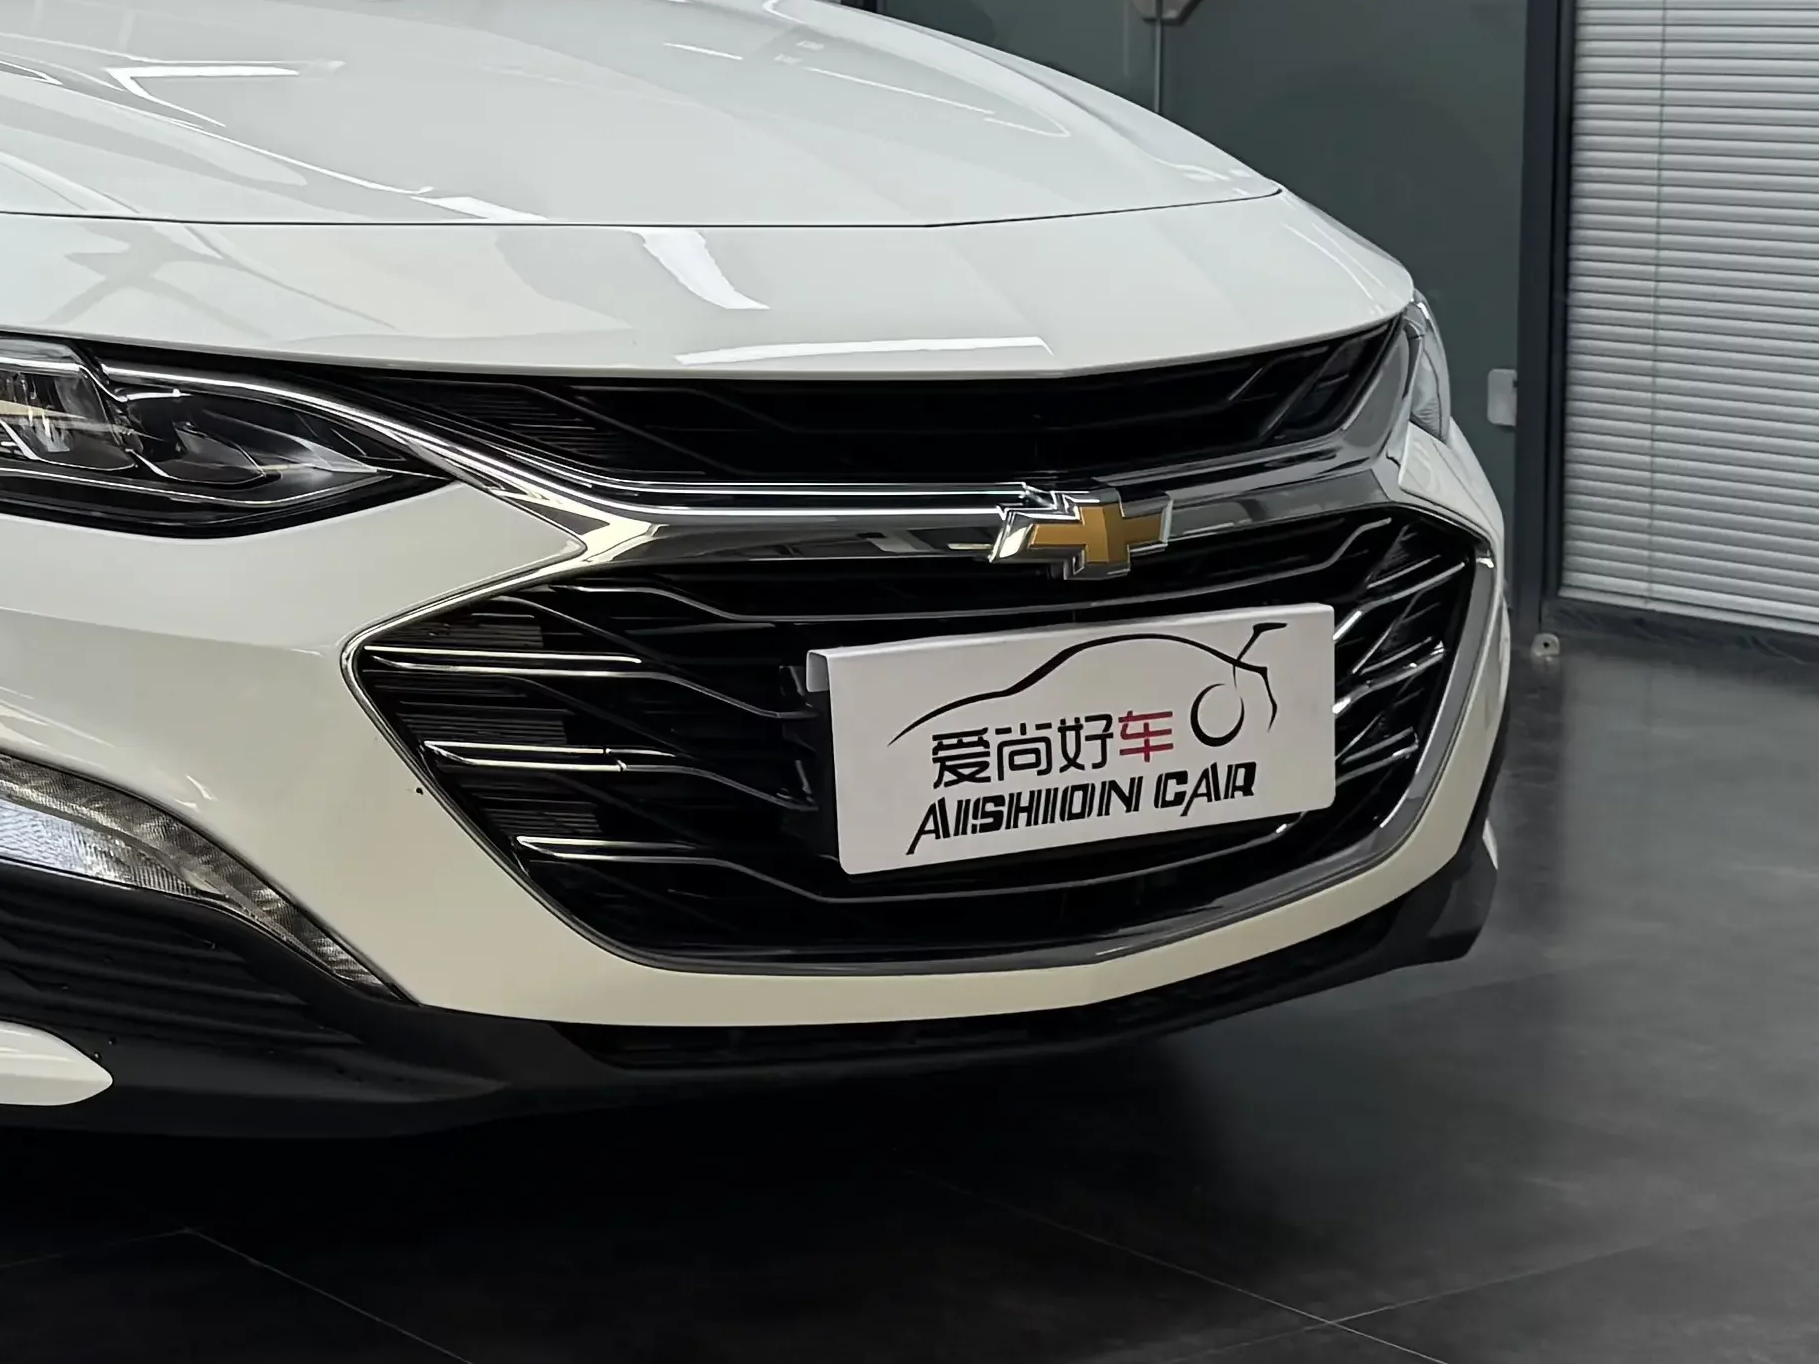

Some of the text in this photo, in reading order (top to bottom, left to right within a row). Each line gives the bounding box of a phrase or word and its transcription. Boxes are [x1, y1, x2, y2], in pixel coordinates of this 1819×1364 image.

[932, 709, 1174, 789] 爱尚好车
[906, 760, 1258, 855] AISHION CAR
